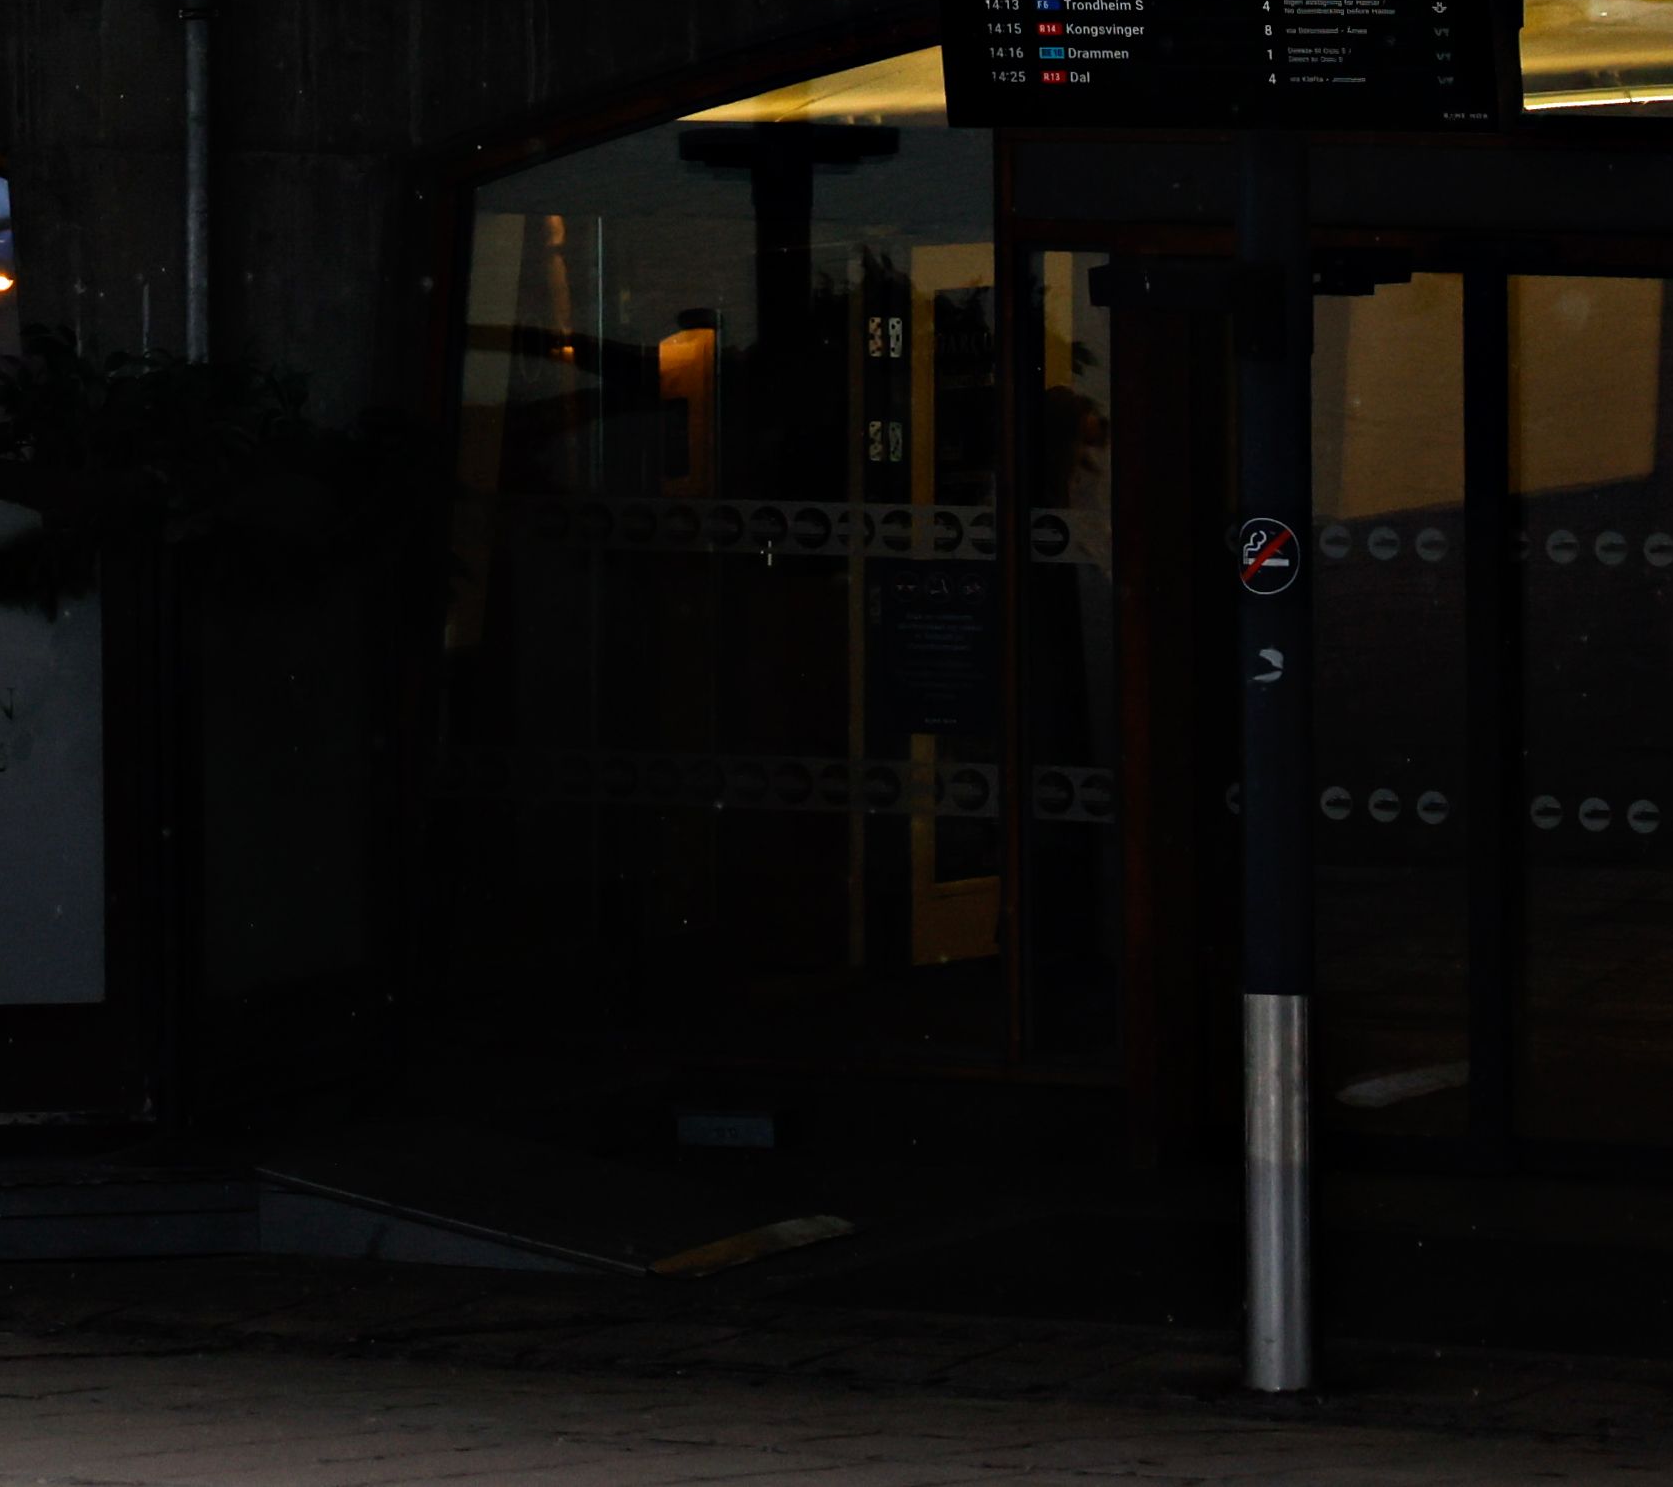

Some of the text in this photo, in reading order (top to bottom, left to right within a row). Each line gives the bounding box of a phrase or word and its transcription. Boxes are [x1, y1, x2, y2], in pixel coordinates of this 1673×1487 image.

[985, 0, 1019, 11] 14:13
[1037, 0, 1049, 9] F6
[1063, 0, 1132, 11] Trondheim
[1135, 0, 1144, 11] S
[1262, 0, 1271, 12] 4
[987, 22, 1022, 35] 14:15
[1039, 24, 1056, 33] R14
[1066, 23, 1145, 38] Kongsvinger
[1264, 24, 1273, 36] 8
[990, 46, 1024, 59] 14:16
[1068, 47, 1129, 59] Drammen
[1267, 49, 1273, 60] 1
[991, 70, 1026, 83] 14:25
[1043, 72, 1061, 81] R13
[1070, 71, 1090, 83] Dal
[1268, 73, 1277, 84] 4
